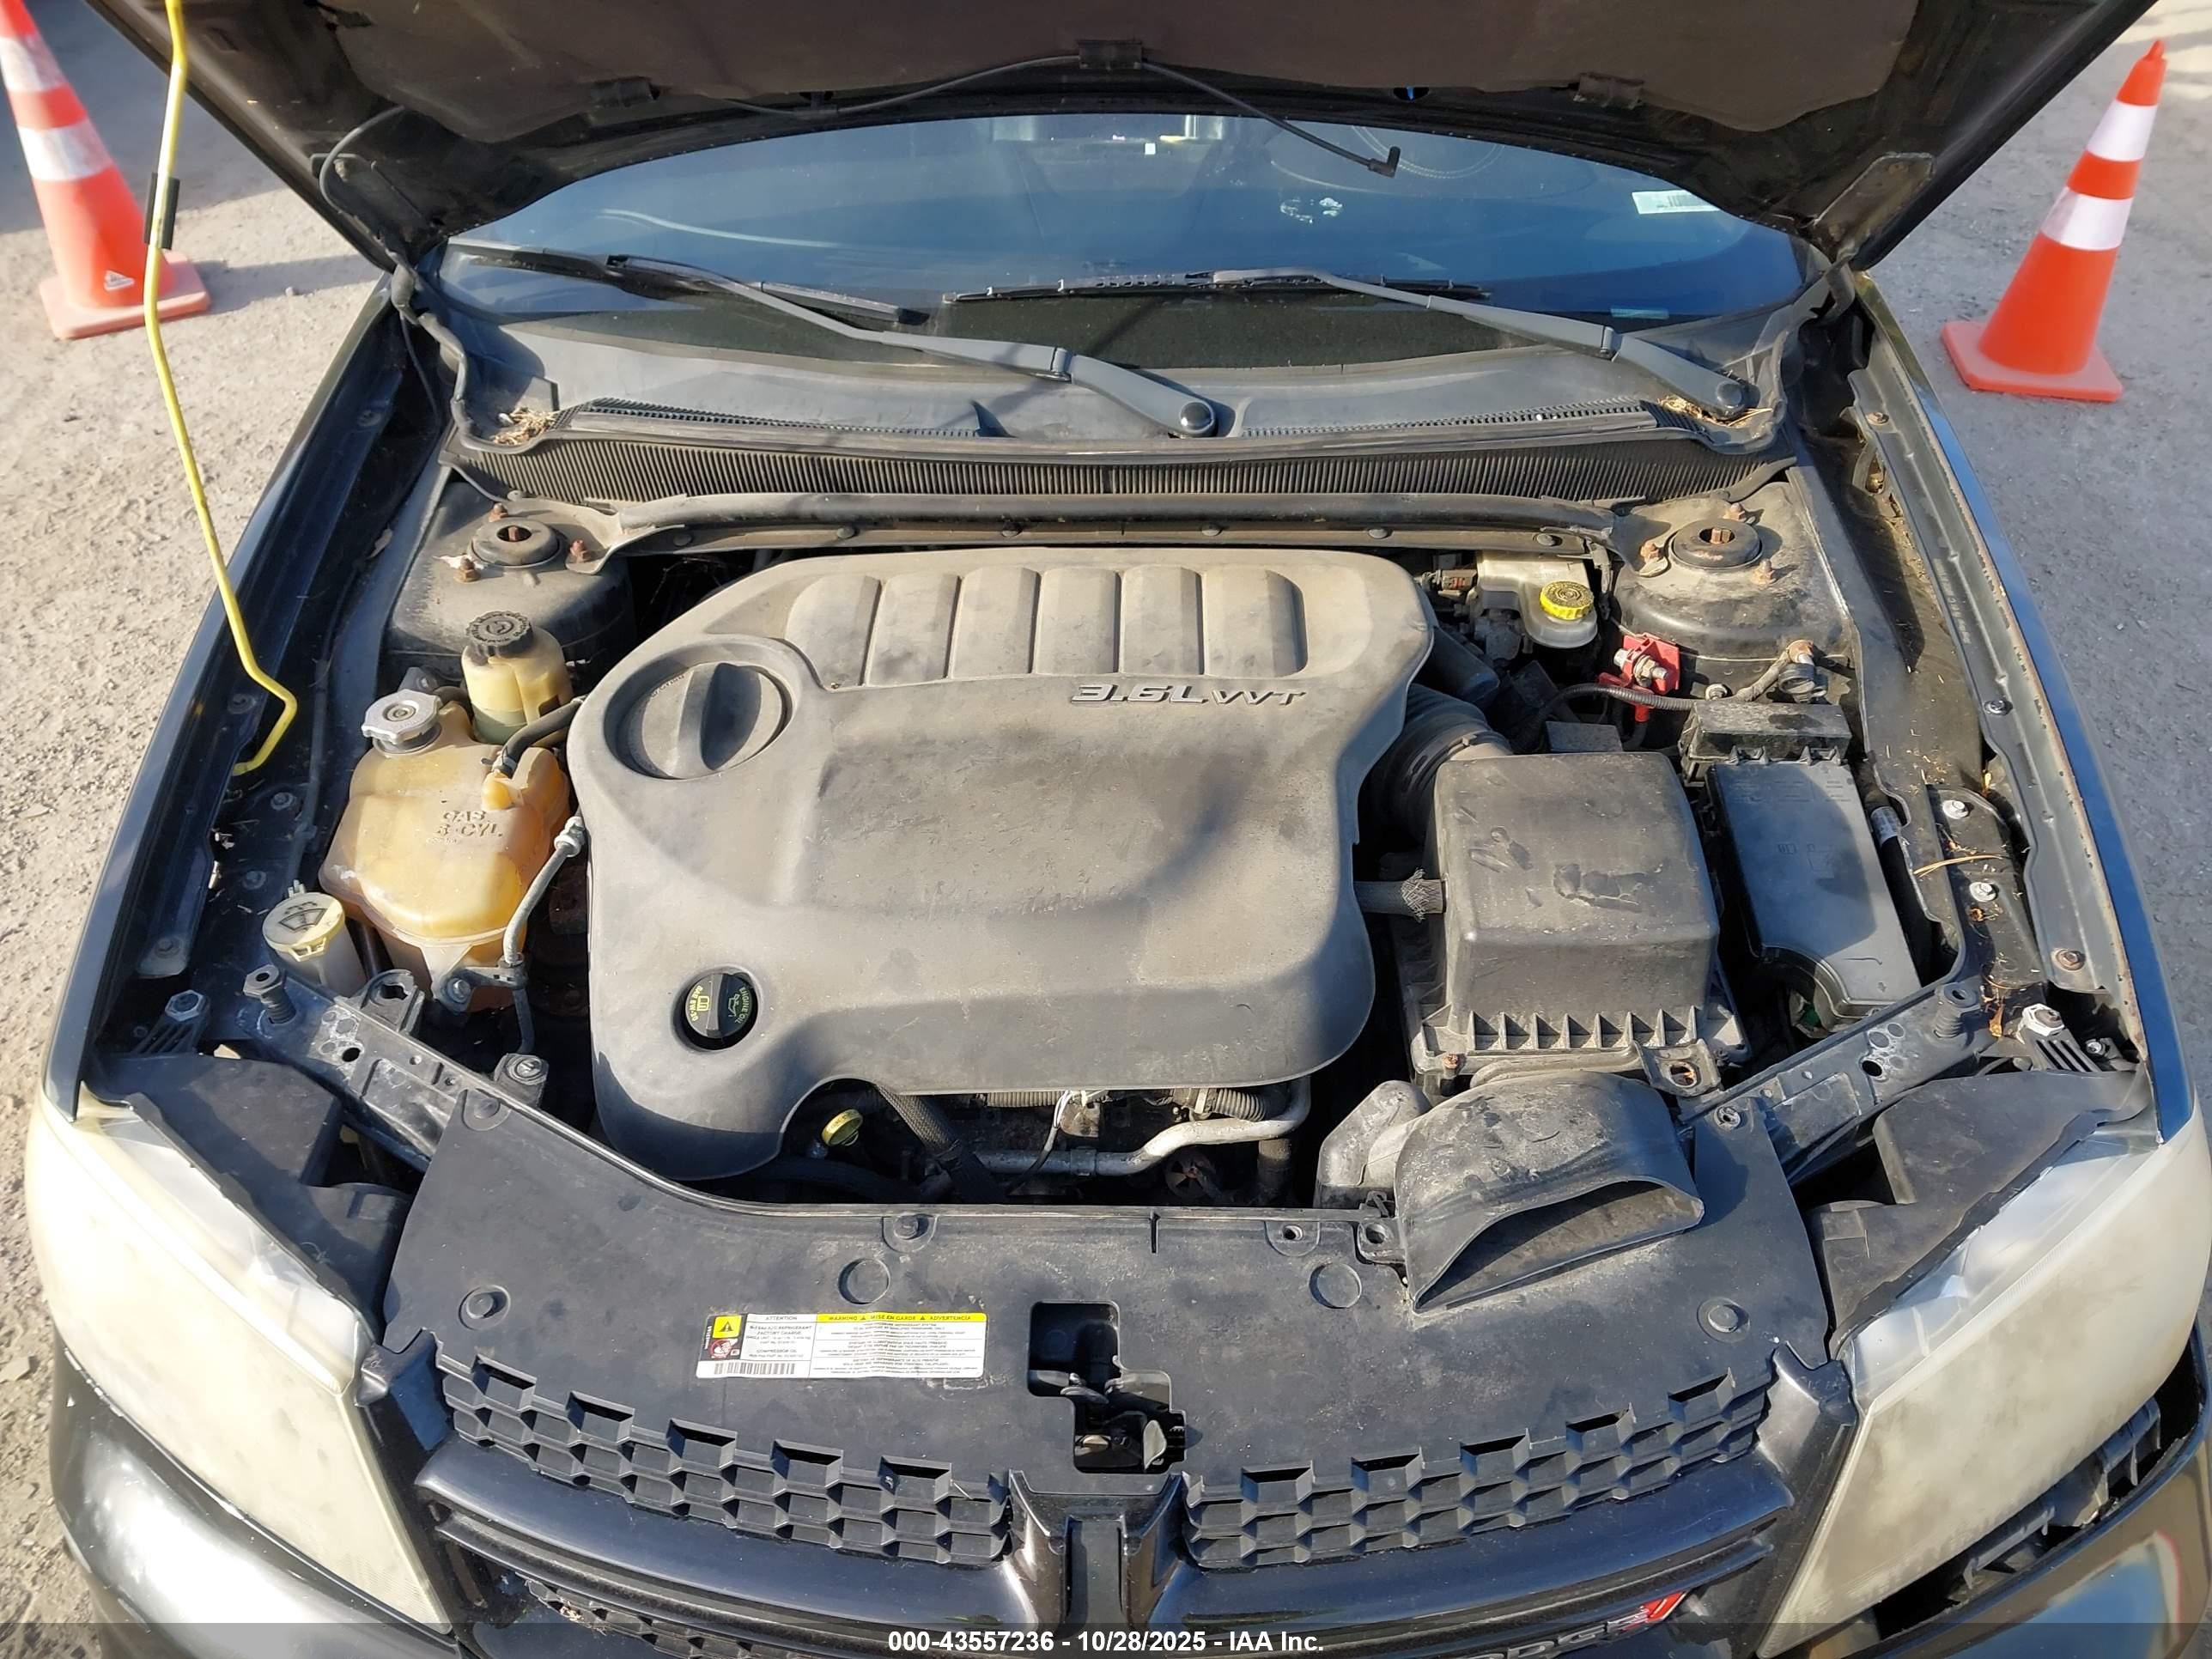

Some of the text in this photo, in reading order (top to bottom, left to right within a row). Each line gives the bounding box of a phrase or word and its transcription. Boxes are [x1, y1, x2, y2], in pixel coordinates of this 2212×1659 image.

[1071, 684, 1306, 706] 3.6L VVT
[734, 987, 750, 1024] ENGINE OIL
